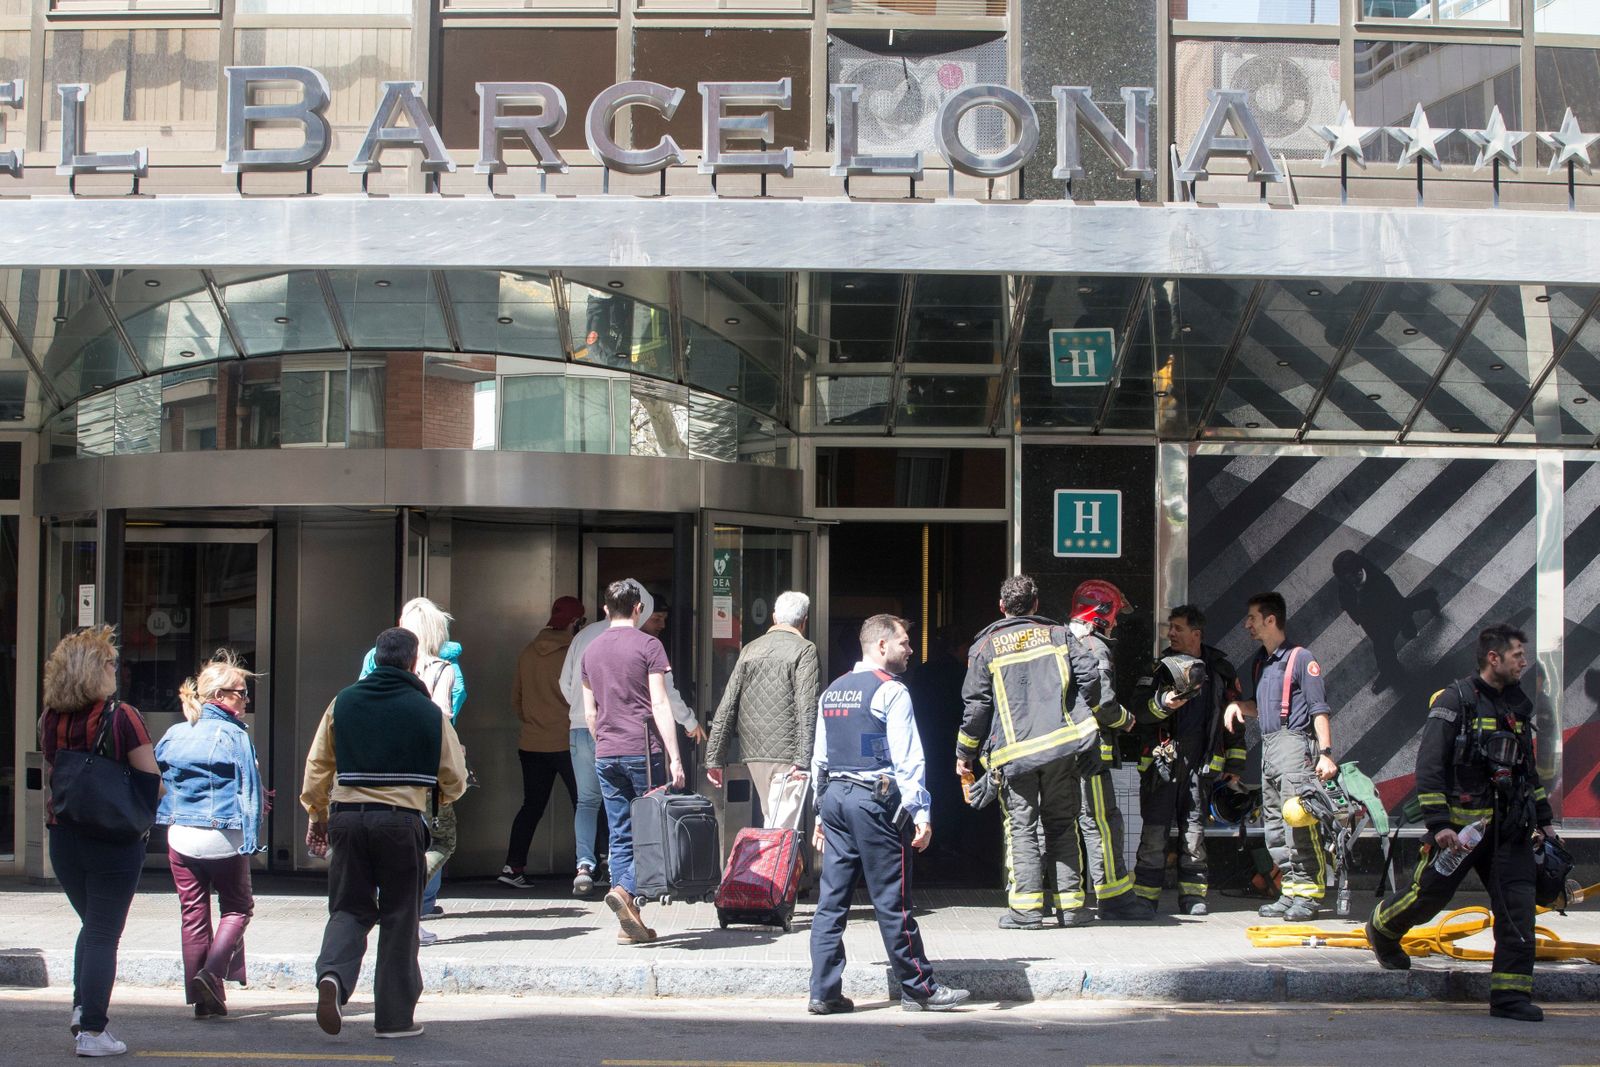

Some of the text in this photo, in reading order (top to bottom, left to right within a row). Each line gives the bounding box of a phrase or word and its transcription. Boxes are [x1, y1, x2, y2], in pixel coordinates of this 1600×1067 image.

[222, 65, 1286, 183] BARCELONA
[1073, 500, 1102, 534] H
[712, 578, 731, 588] DEA
[994, 636, 1052, 656] BARCELONA
[824, 690, 863, 702] POLICIA
